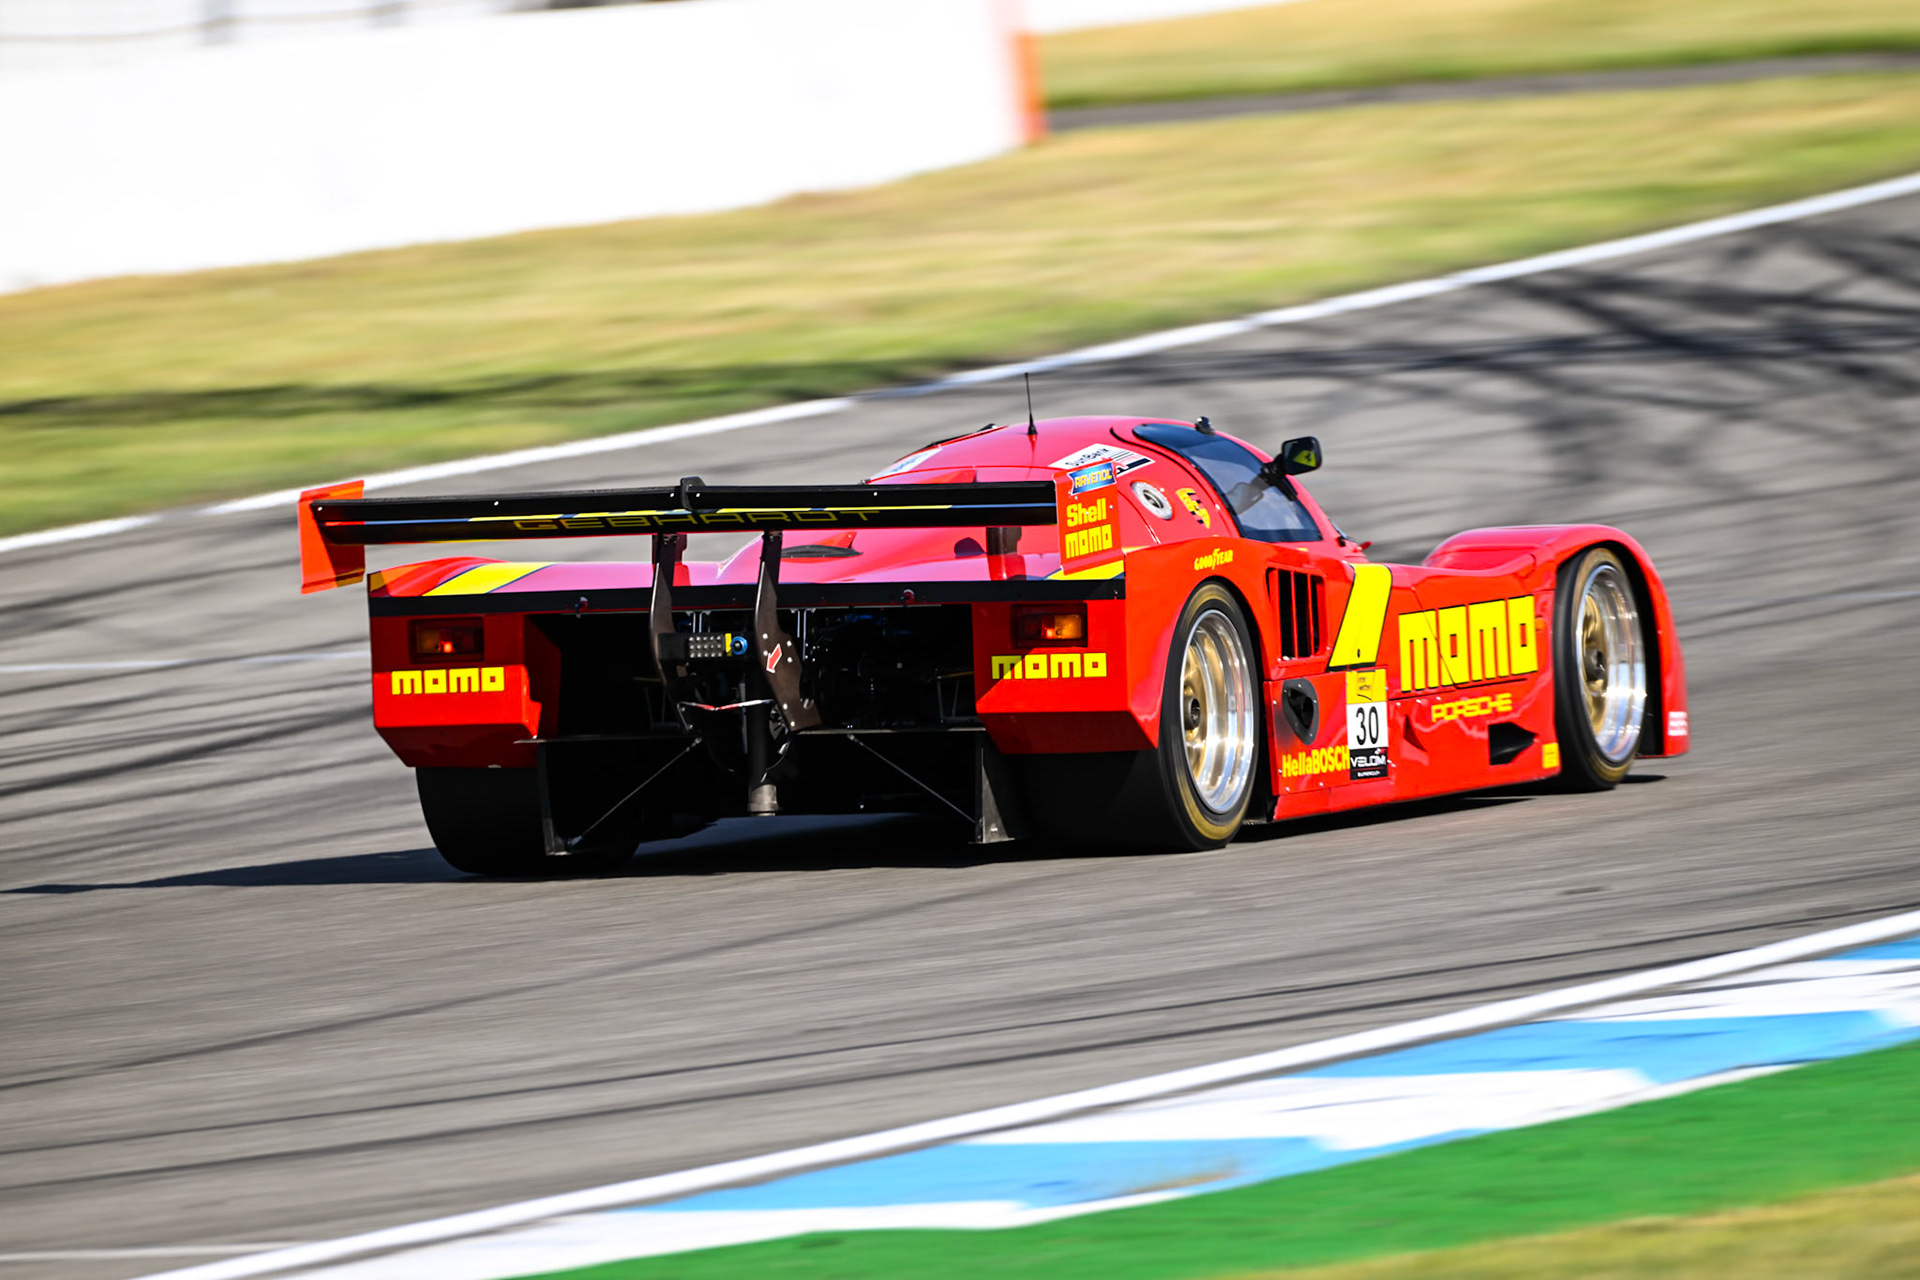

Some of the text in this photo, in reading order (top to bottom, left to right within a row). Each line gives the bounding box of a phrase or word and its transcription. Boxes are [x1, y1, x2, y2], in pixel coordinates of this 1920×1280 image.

[1074, 469, 1113, 489] RAVENOL
[1066, 498, 1107, 527] Shell
[1065, 524, 1113, 559] momo
[1194, 548, 1233, 571] GOODYEAR
[1398, 594, 1538, 693] momo
[991, 652, 1107, 680] momo
[391, 667, 505, 695] momo
[1431, 693, 1512, 722] PORSCHE
[1356, 706, 1379, 745] 30
